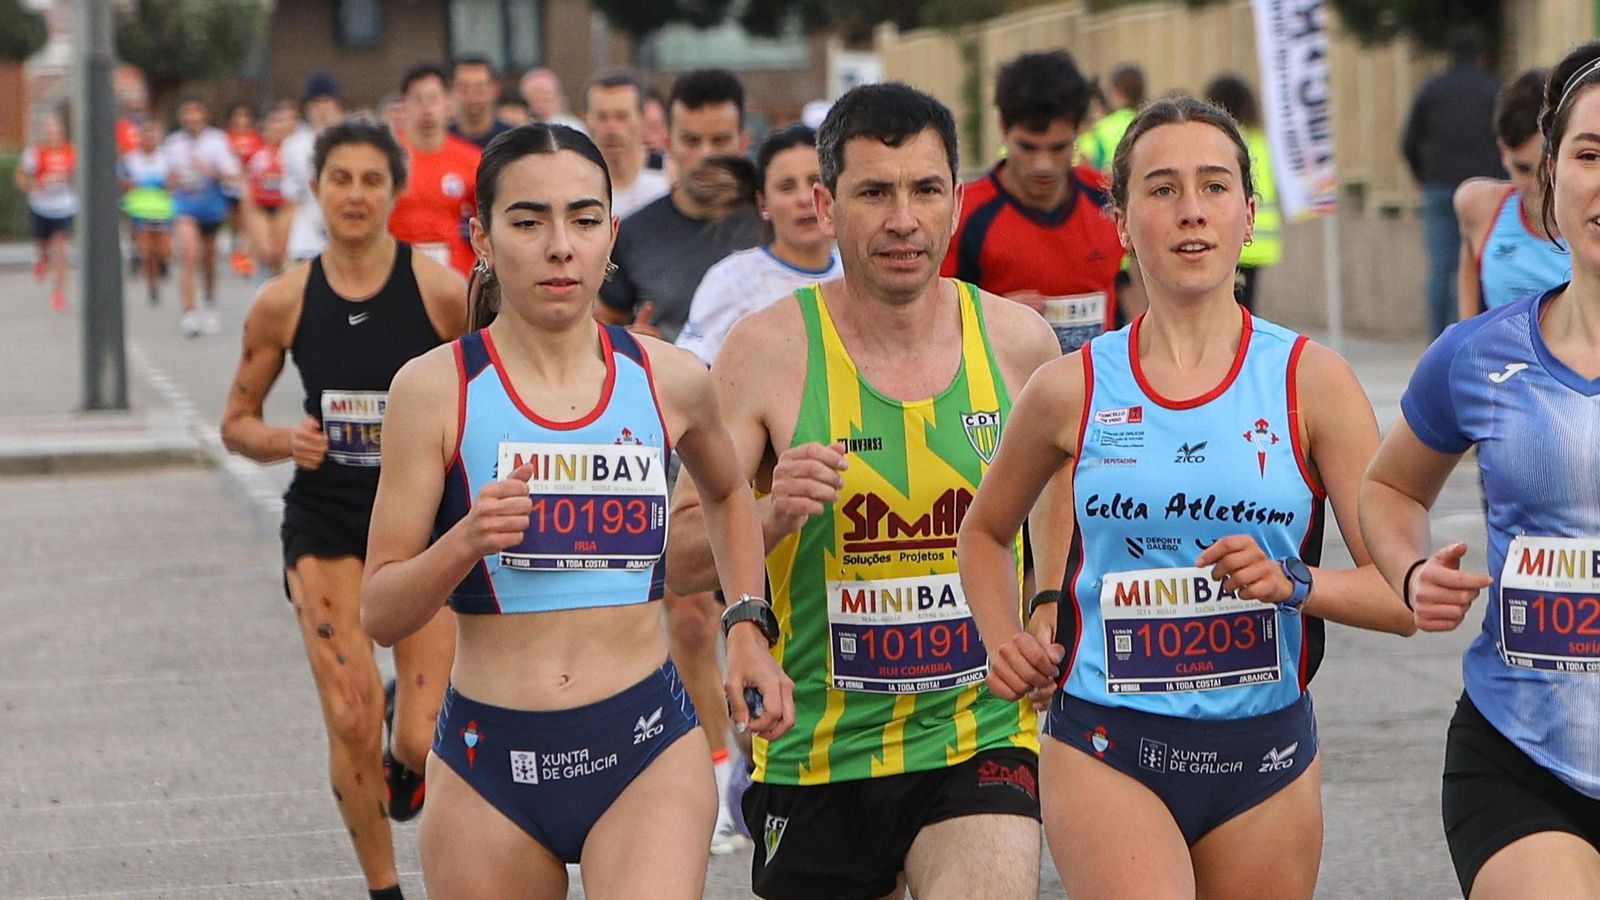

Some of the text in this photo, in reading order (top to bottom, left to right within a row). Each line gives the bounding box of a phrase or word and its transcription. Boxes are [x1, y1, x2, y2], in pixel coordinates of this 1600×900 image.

[1174, 455, 1206, 464] ZICO
[513, 453, 651, 482] MINIBAY
[531, 498, 648, 535] 10193
[1086, 492, 1295, 527] Celta Atletismo
[574, 540, 597, 552] IRIA
[566, 560, 583, 568] TODA
[843, 552, 892, 566] Soluções
[900, 550, 945, 563] Projetos
[1532, 595, 1600, 635] 102
[861, 622, 970, 661] 10191
[1137, 615, 1257, 657] 10203
[879, 662, 953, 677] RUI COIMBRA
[1175, 661, 1215, 673] CLARA
[1565, 661, 1585, 671] TODA
[898, 683, 915, 692] TODA
[1176, 680, 1195, 690] TODA
[633, 724, 664, 745] ZICO
[541, 748, 589, 766] XUNTA
[1171, 748, 1217, 762] XUNTA
[543, 753, 618, 781] DE GALICIA
[1170, 761, 1243, 774] DE GALICIA
[1258, 758, 1293, 773] ZICO
